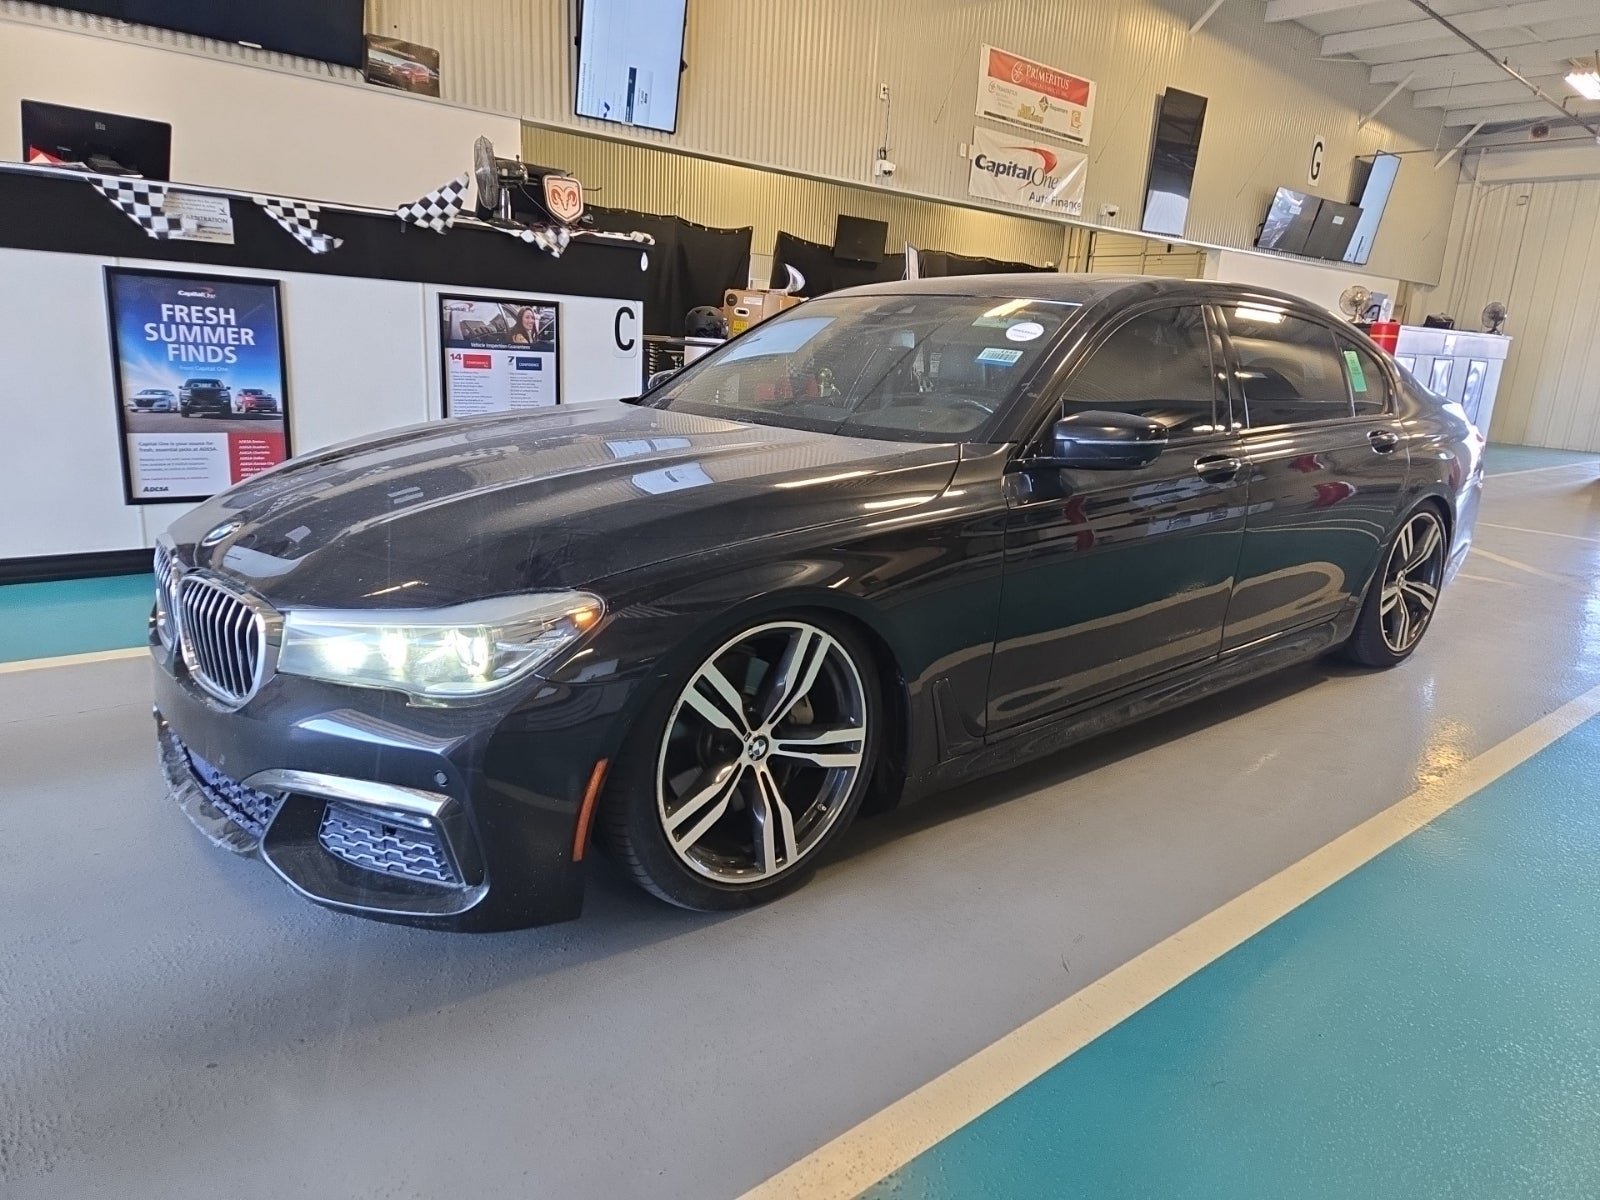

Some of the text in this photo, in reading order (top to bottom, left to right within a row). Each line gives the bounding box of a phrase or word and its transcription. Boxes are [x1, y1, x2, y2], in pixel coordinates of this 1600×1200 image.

[1026, 64, 1070, 90] PRIMERITUS
[1311, 141, 1323, 180] G
[161, 303, 237, 326] FRESH
[144, 322, 256, 346] SUMMER
[615, 306, 635, 351] C
[167, 343, 238, 364] FINDS
[450, 353, 462, 361] 14
[507, 355, 515, 363] 7
